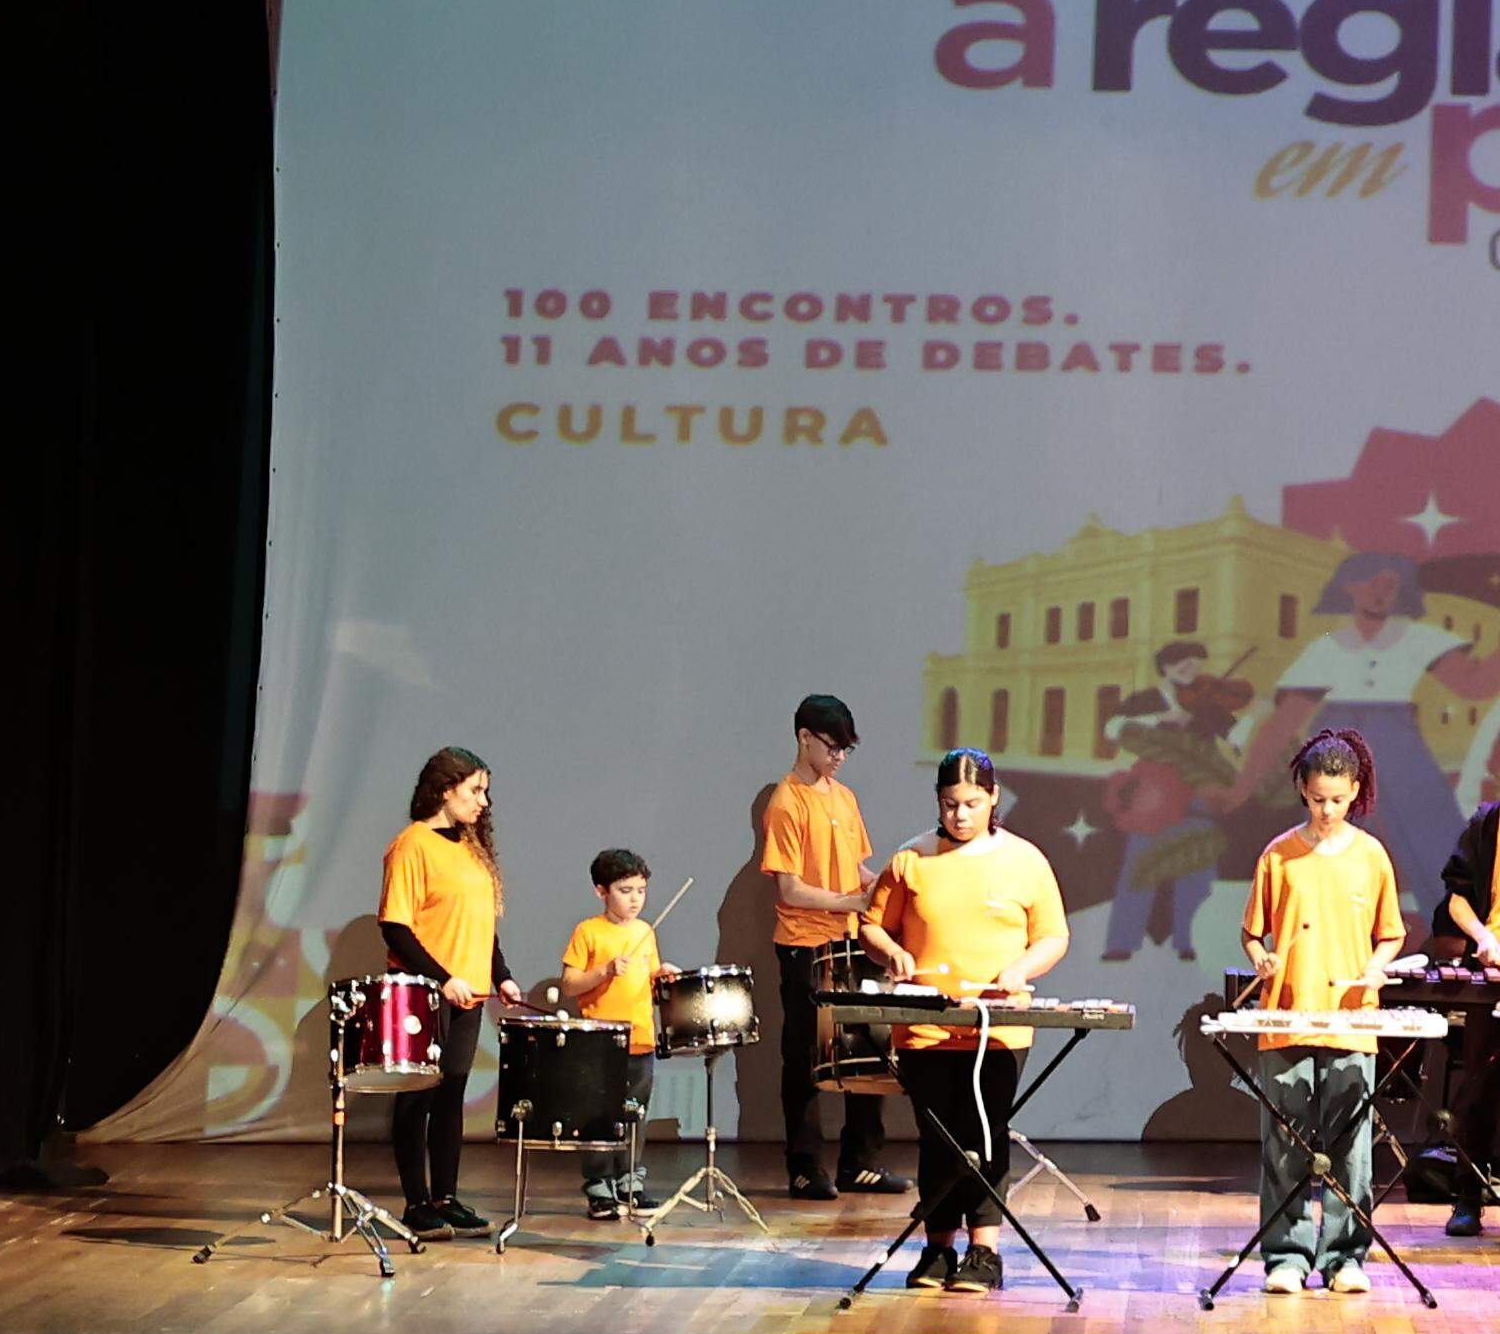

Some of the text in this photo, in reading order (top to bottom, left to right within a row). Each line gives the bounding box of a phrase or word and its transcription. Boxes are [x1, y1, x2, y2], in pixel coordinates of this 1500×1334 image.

[1252, 137, 1408, 201] em
[503, 288, 1081, 326] 100 ENCONTROS.
[499, 334, 1253, 375] 11 ANOS DE DEBATES.
[495, 401, 890, 447] CULTURA
